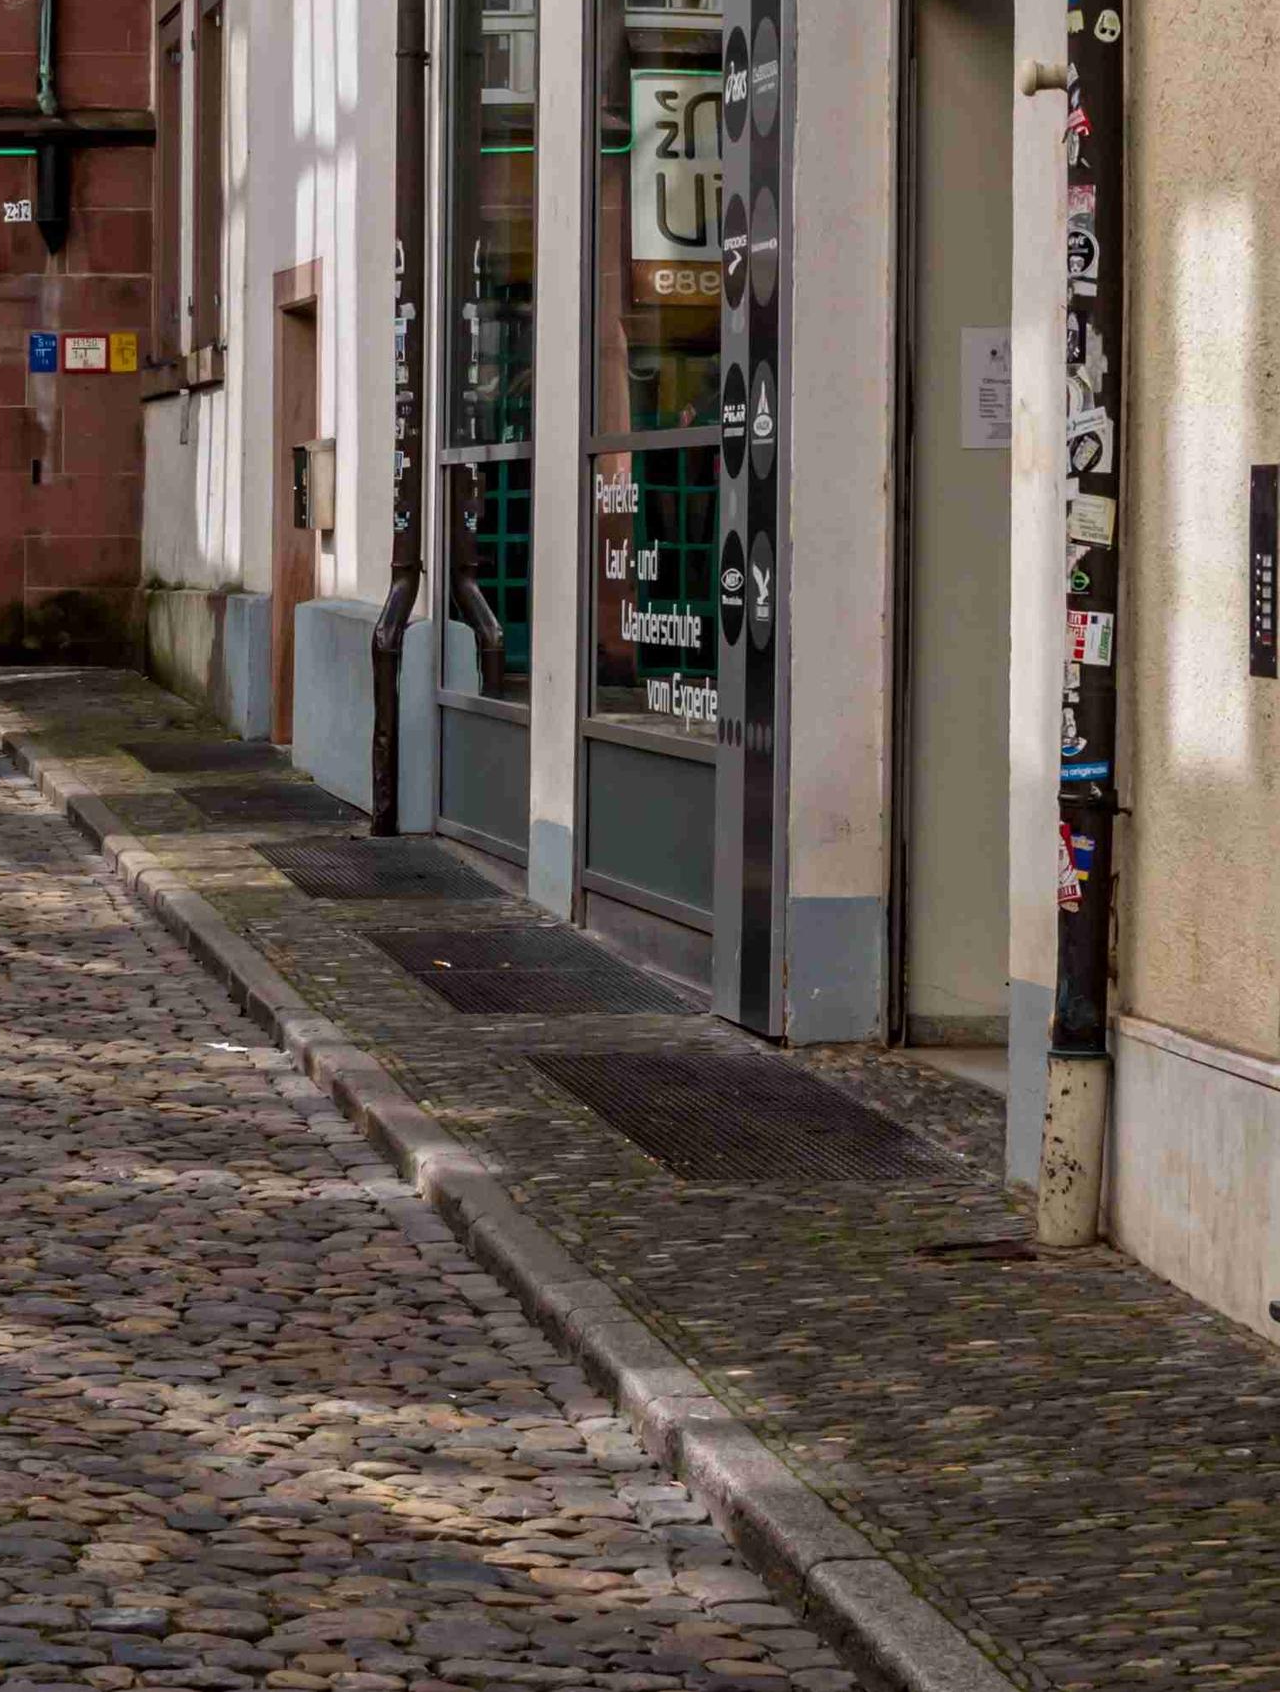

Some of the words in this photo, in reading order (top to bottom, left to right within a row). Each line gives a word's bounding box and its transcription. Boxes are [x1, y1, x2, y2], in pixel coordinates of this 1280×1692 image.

[595, 473, 639, 514] Perfekte
[605, 539, 628, 580] Lauf
[637, 539, 658, 581] und
[621, 599, 702, 648] Wanderschuhe
[647, 678, 670, 714] vom
